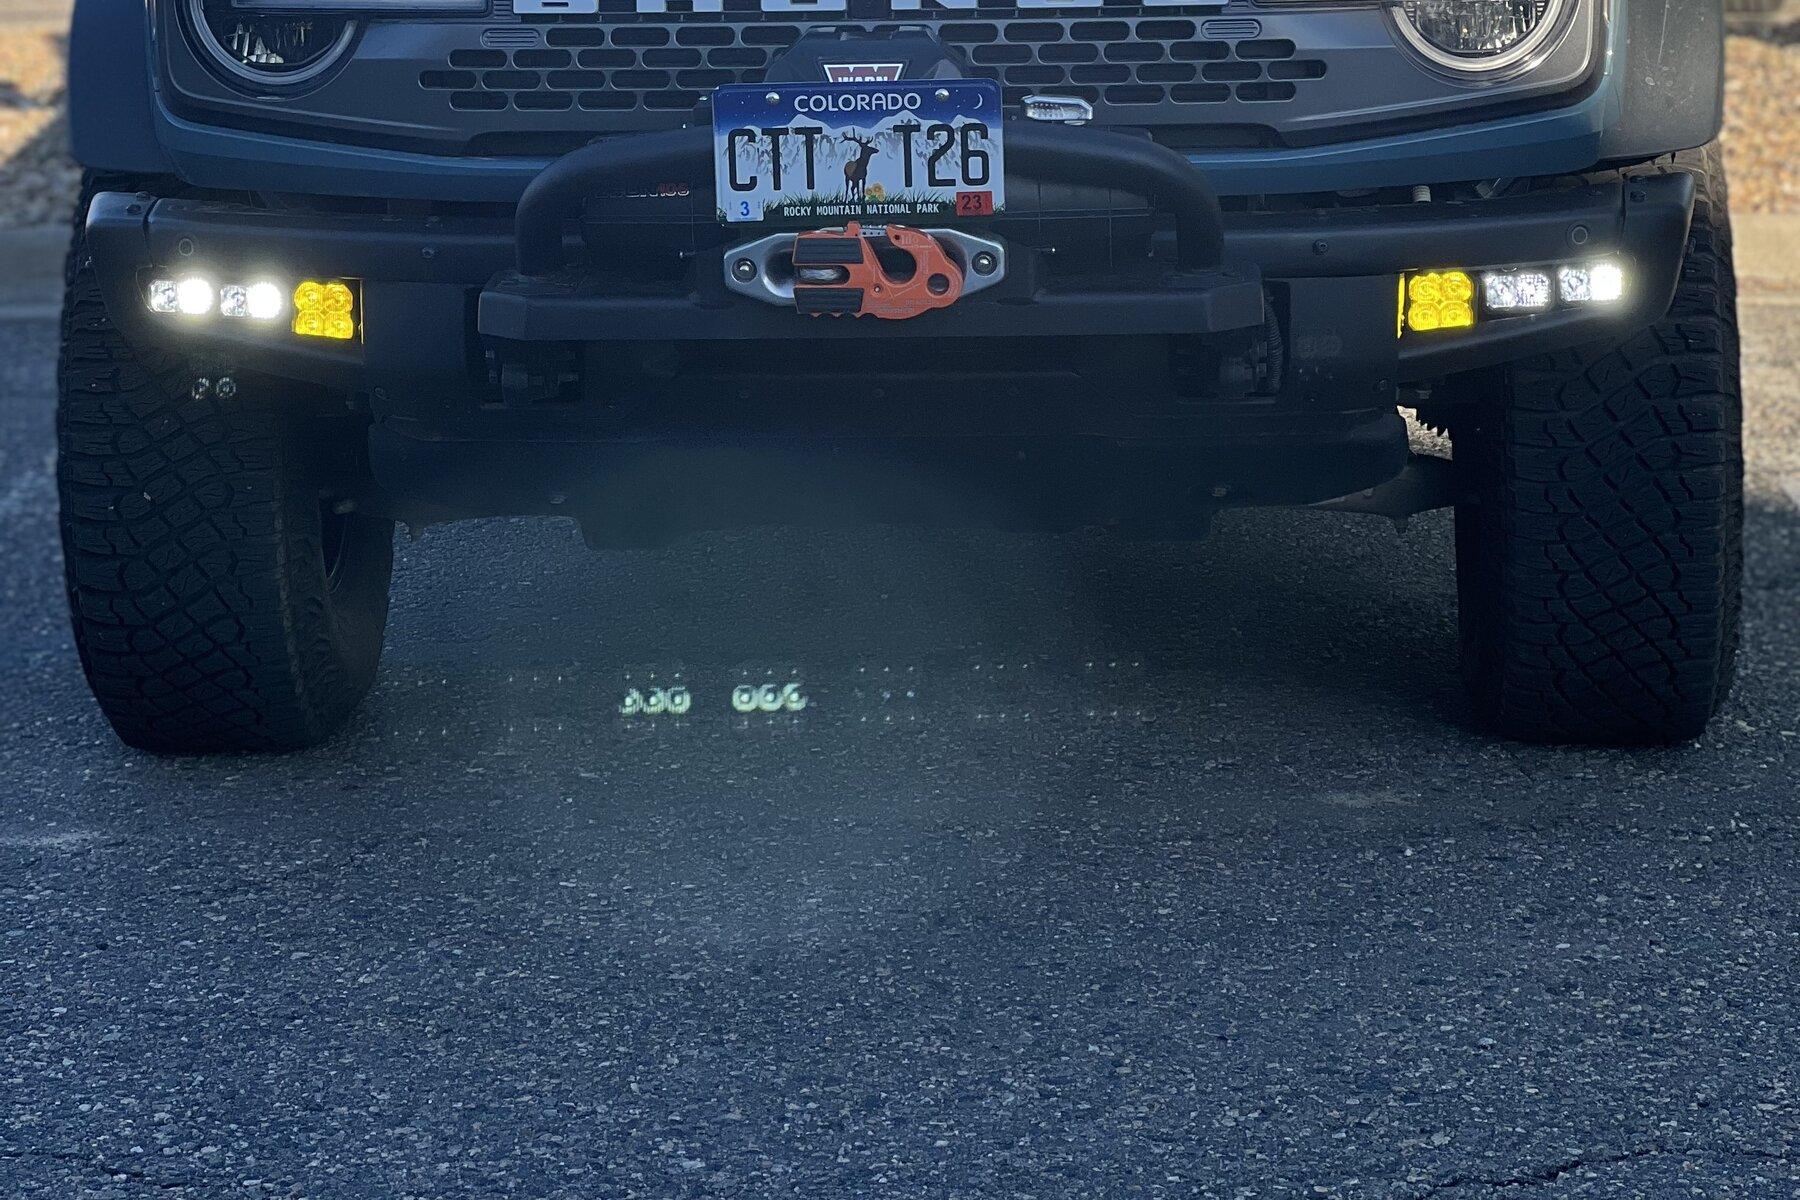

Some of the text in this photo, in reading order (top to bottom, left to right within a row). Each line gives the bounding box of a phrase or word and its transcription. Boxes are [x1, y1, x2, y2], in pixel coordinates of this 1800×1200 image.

[793, 92, 922, 113] COLORADO
[727, 123, 990, 192] CTT T26
[740, 201, 750, 217] 3
[783, 203, 940, 217] ROCKY MOUNTAIN NATIONAL PARK
[961, 194, 982, 211] 23
